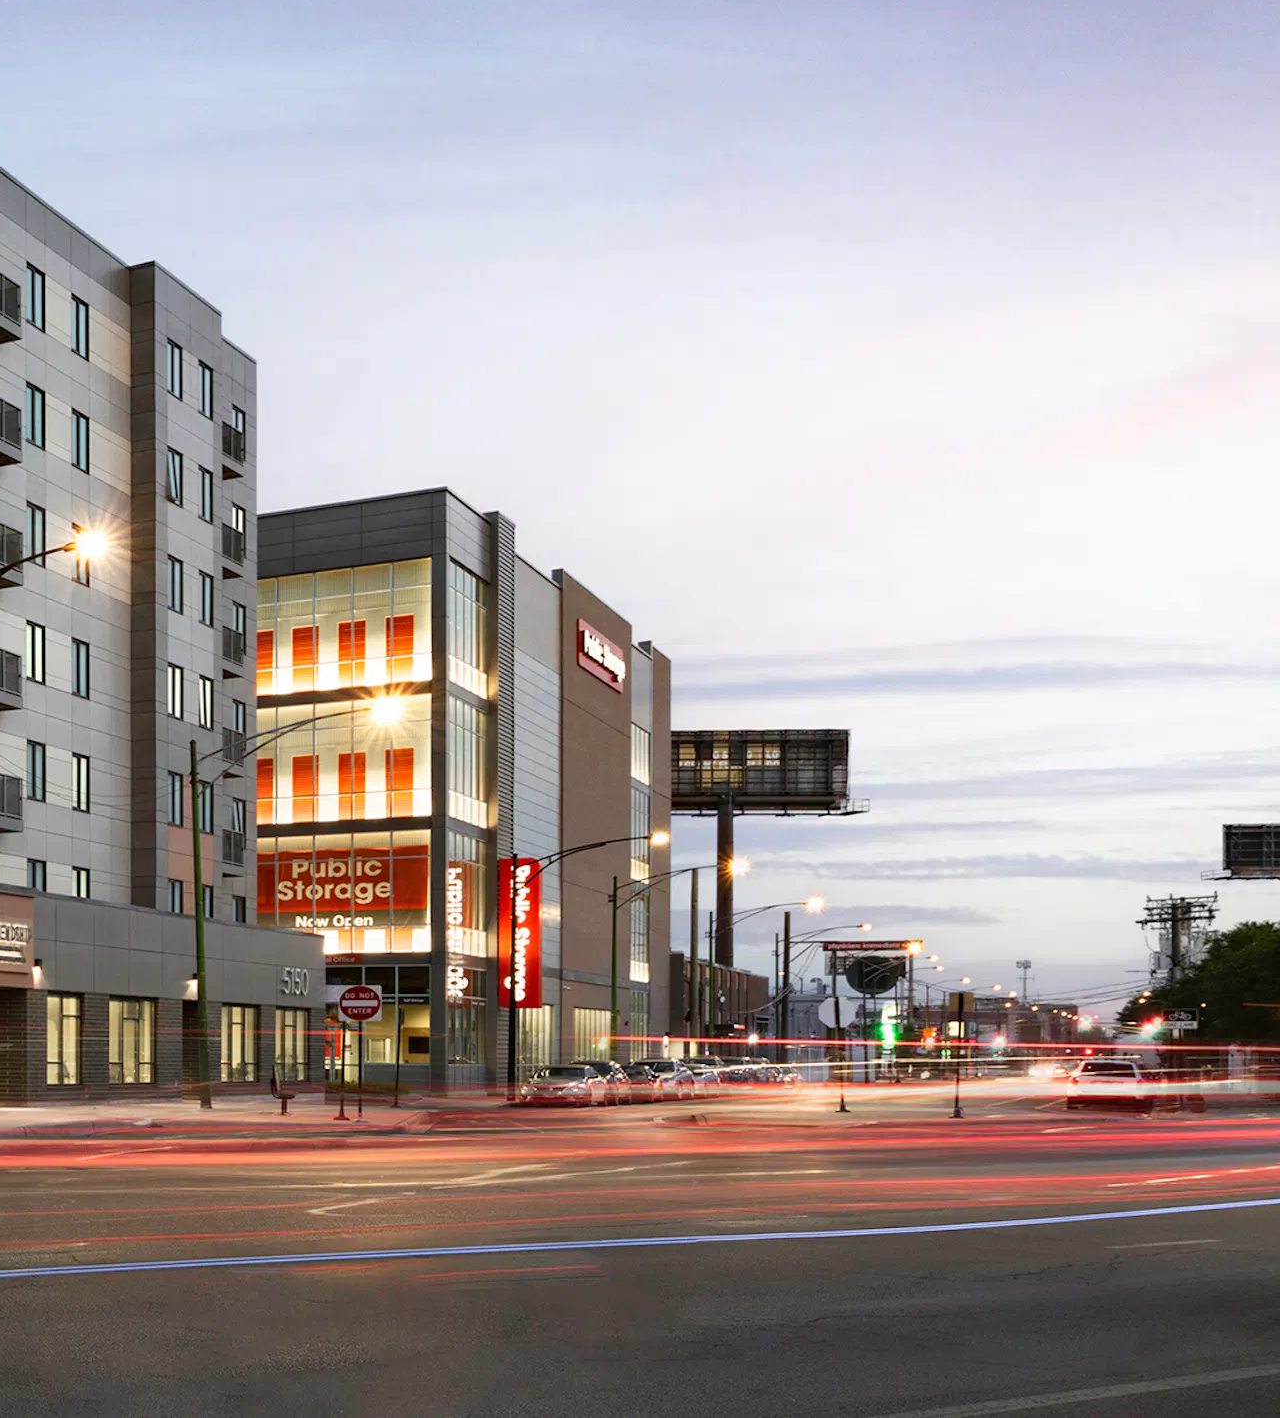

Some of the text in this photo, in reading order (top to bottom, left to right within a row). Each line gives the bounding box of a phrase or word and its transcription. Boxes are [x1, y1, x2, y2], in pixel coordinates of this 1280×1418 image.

[292, 857, 383, 879] Public
[278, 880, 390, 904] Storage
[295, 915, 329, 927] Now
[333, 915, 373, 930] Open
[283, 967, 309, 996] 5150
[347, 1007, 372, 1015] ENTER
